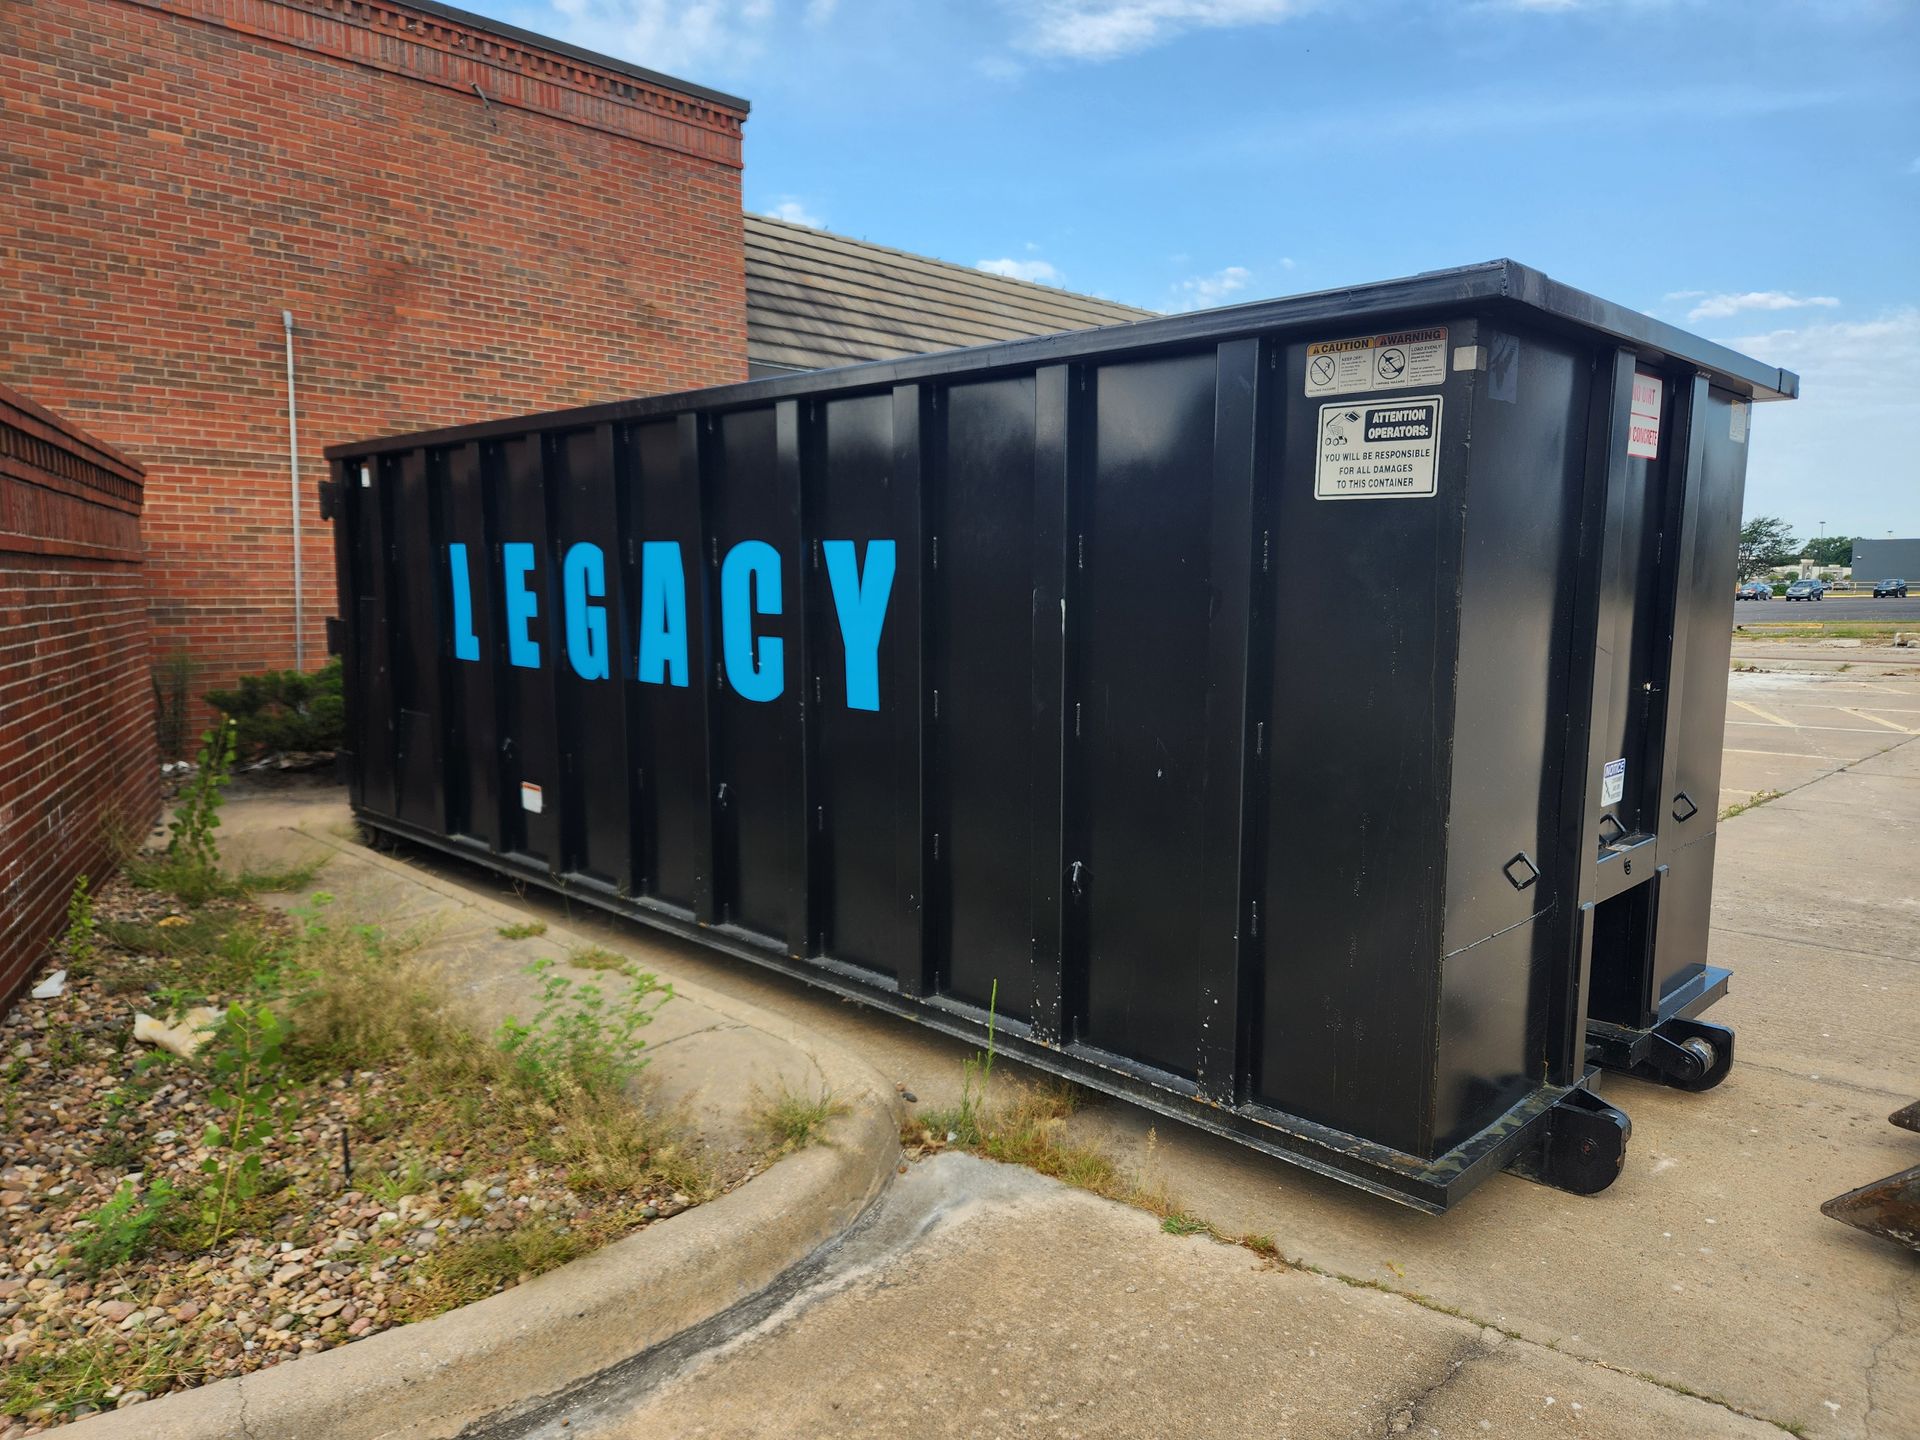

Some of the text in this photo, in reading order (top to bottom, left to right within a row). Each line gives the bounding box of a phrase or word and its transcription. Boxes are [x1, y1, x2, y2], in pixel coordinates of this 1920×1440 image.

[1387, 330, 1441, 345] WARNING
[1321, 339, 1369, 353] CAUTION
[1372, 408, 1426, 424] ATTENTION
[1367, 424, 1429, 440] OPERATORS:
[1632, 426, 1657, 446] CONCRETE
[1325, 448, 1430, 462] YOU WILL BE RESPONSIBLE
[1339, 464, 1413, 475] FOR ALL DAMAGES
[1337, 477, 1414, 489] TO THIS CONTAINER
[449, 540, 896, 712] LEGACY
